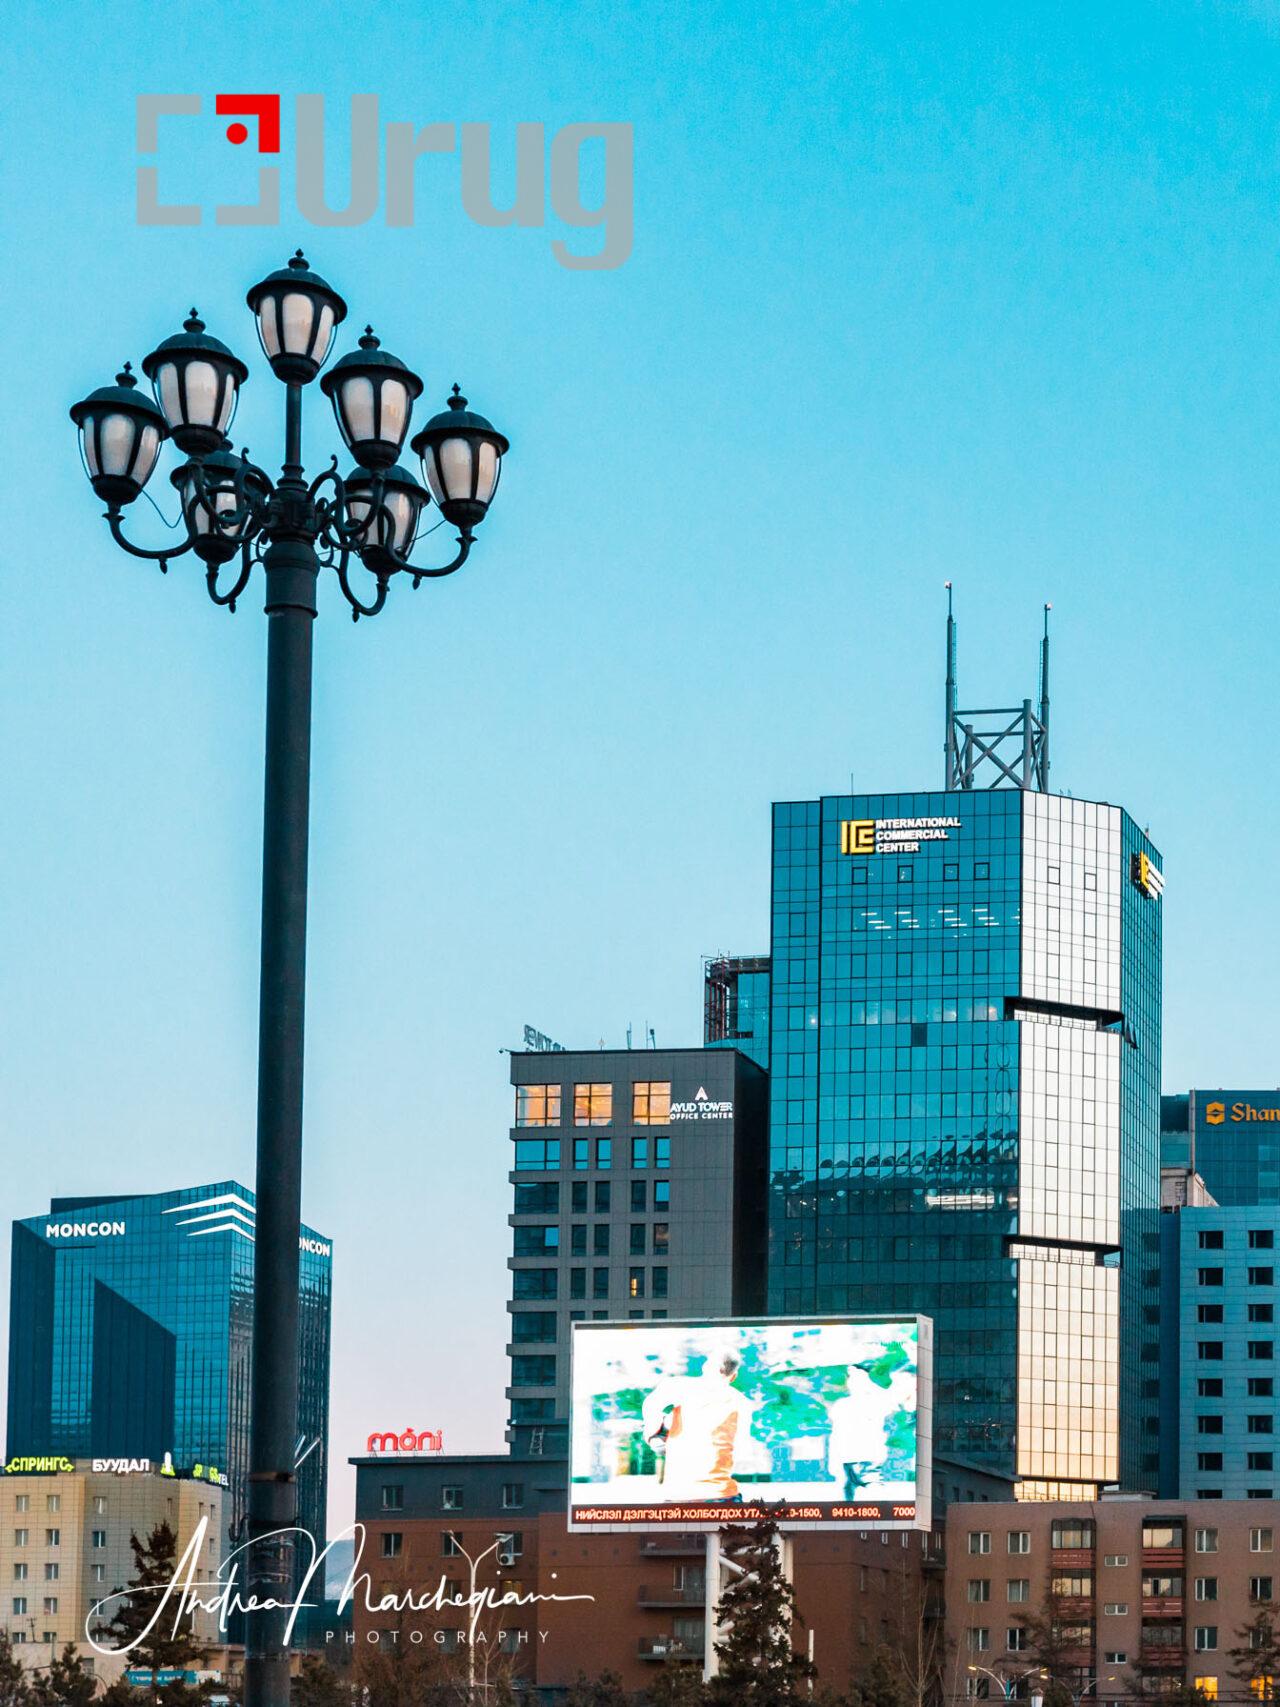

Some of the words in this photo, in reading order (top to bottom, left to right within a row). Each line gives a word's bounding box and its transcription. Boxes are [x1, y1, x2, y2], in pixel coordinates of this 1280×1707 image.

[875, 817, 961, 829] INTERNATIONAL
[875, 829, 948, 841] COMMERCIAL
[875, 842, 919, 853] CENTER
[670, 1102, 697, 1112] AYUD
[698, 1102, 733, 1112] TOWER
[46, 1221, 126, 1238] MONCON
[11, 1457, 68, 1472] СПРИНГС
[92, 1459, 150, 1474] БУУДАЛ
[575, 1508, 622, 1520] НИЙСЛЭЛ
[623, 1508, 681, 1521] ДЭЛГЭЦТЭЙ
[683, 1508, 741, 1520] ХОЛБОГДОХ
